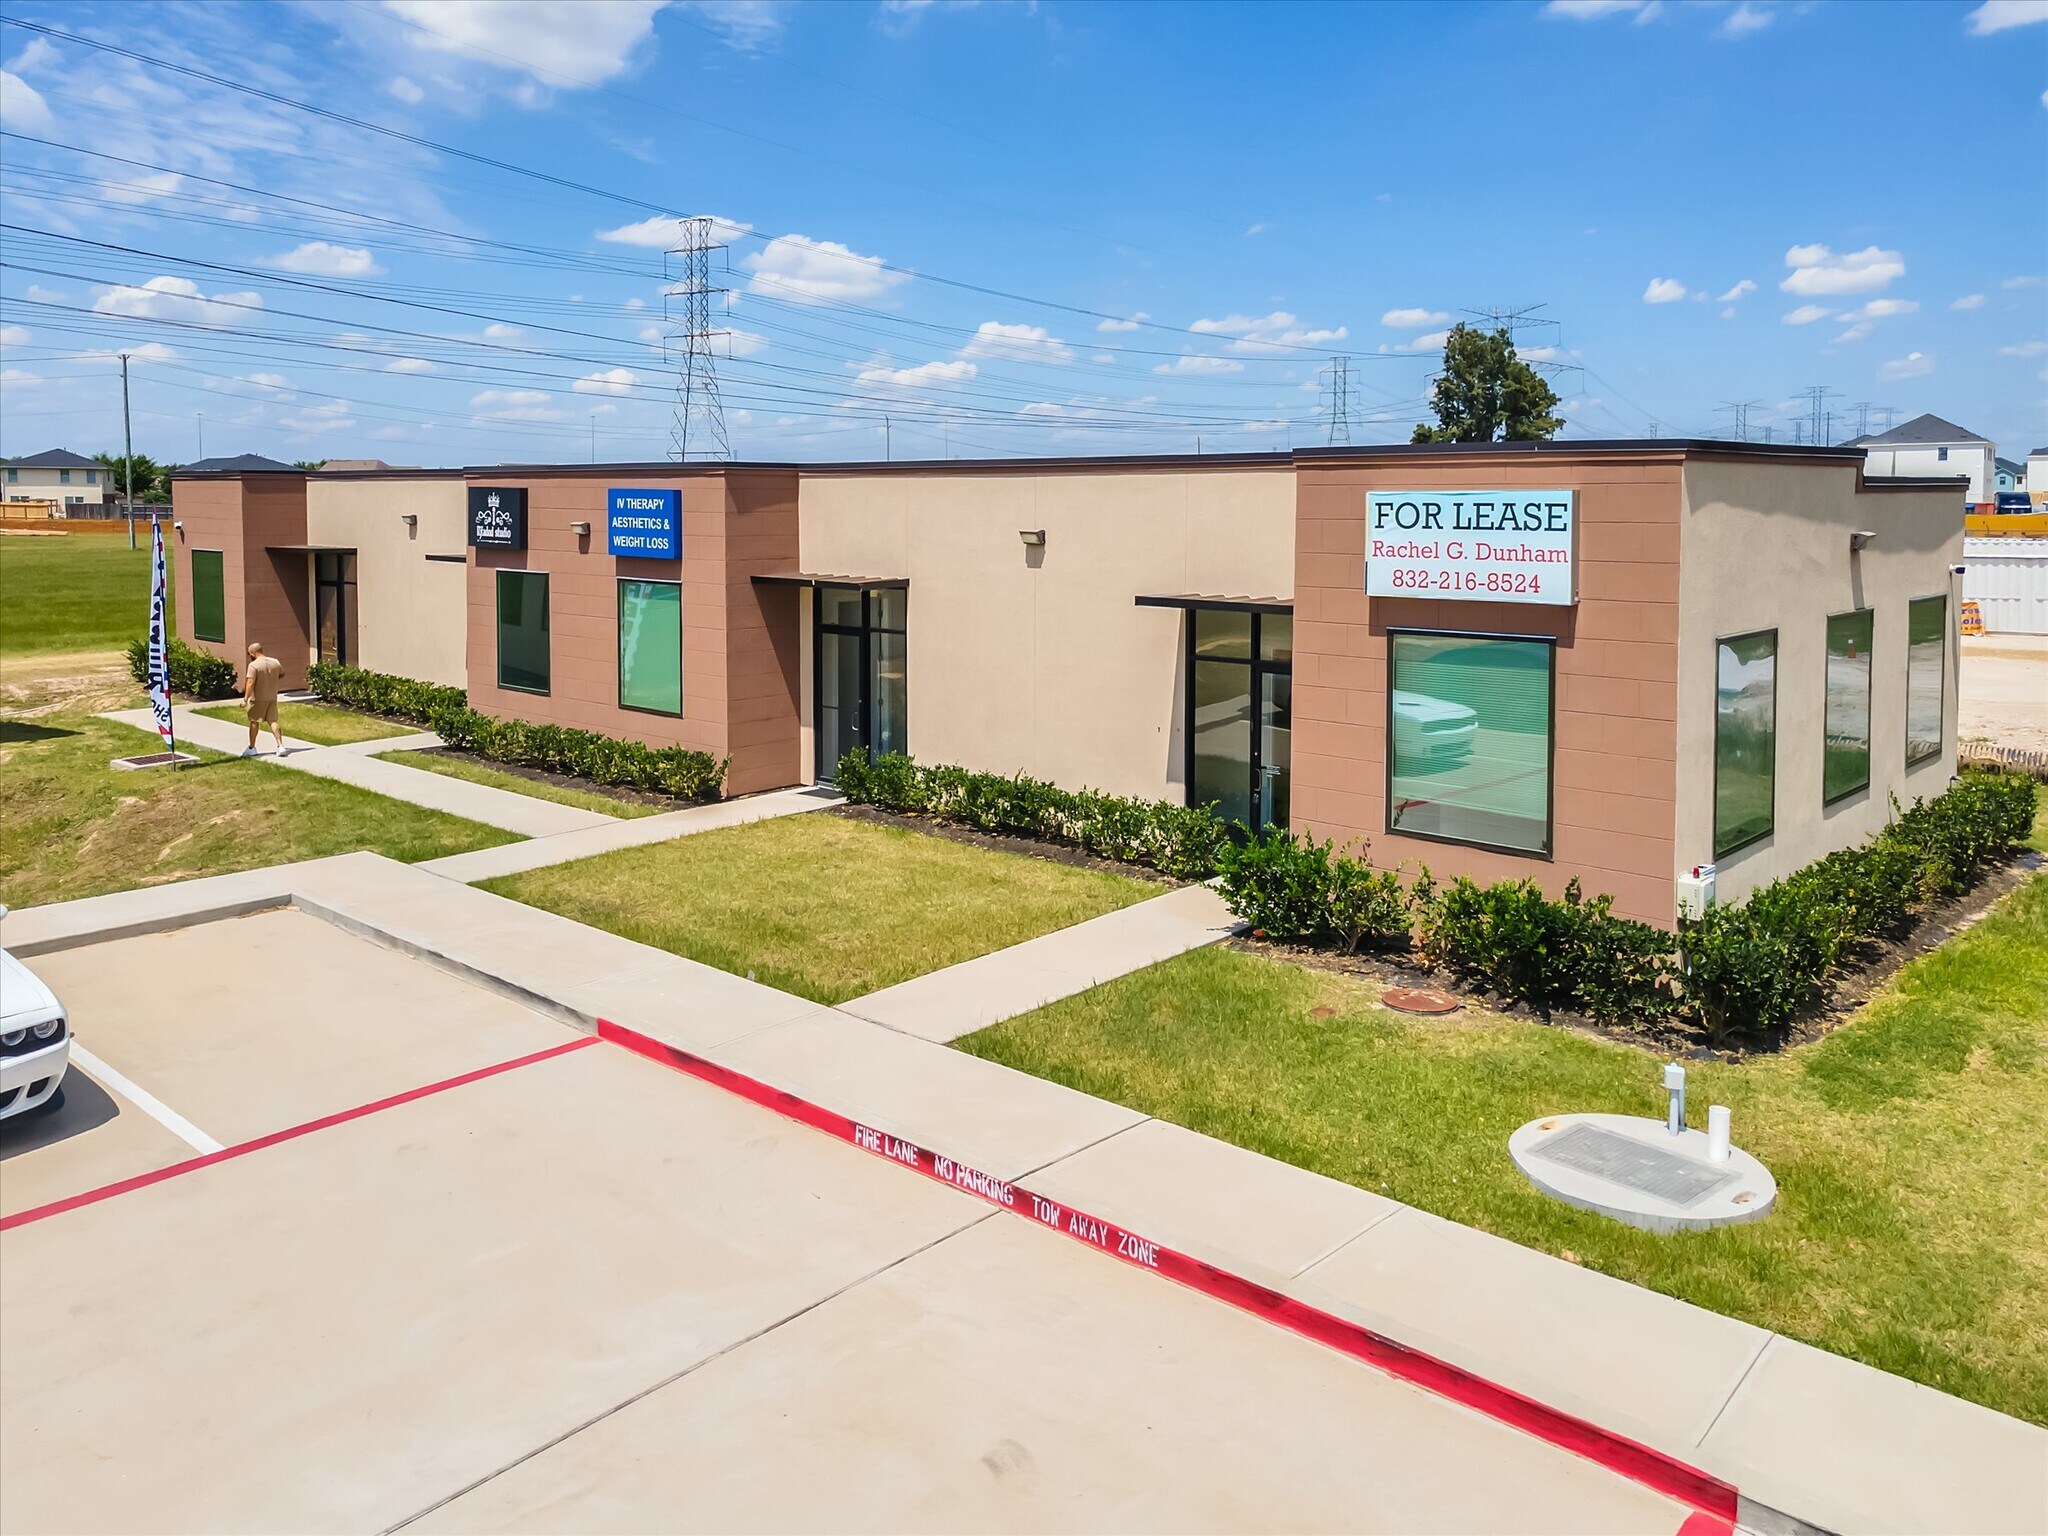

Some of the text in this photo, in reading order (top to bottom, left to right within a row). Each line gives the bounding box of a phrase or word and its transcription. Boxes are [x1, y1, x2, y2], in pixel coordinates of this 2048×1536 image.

[617, 498, 664, 510] IV THERAPY
[612, 517, 670, 530] AESTHETICS &
[1374, 502, 1568, 532] FOR LEASE
[613, 535, 669, 549] WEIGHT LOSS
[1372, 540, 1568, 563] Rachel G. Dunham
[1392, 569, 1541, 594] 832-216-8524
[855, 1124, 1159, 1267] FIRE LANE NO PARKING TOW AWAY ZONE
